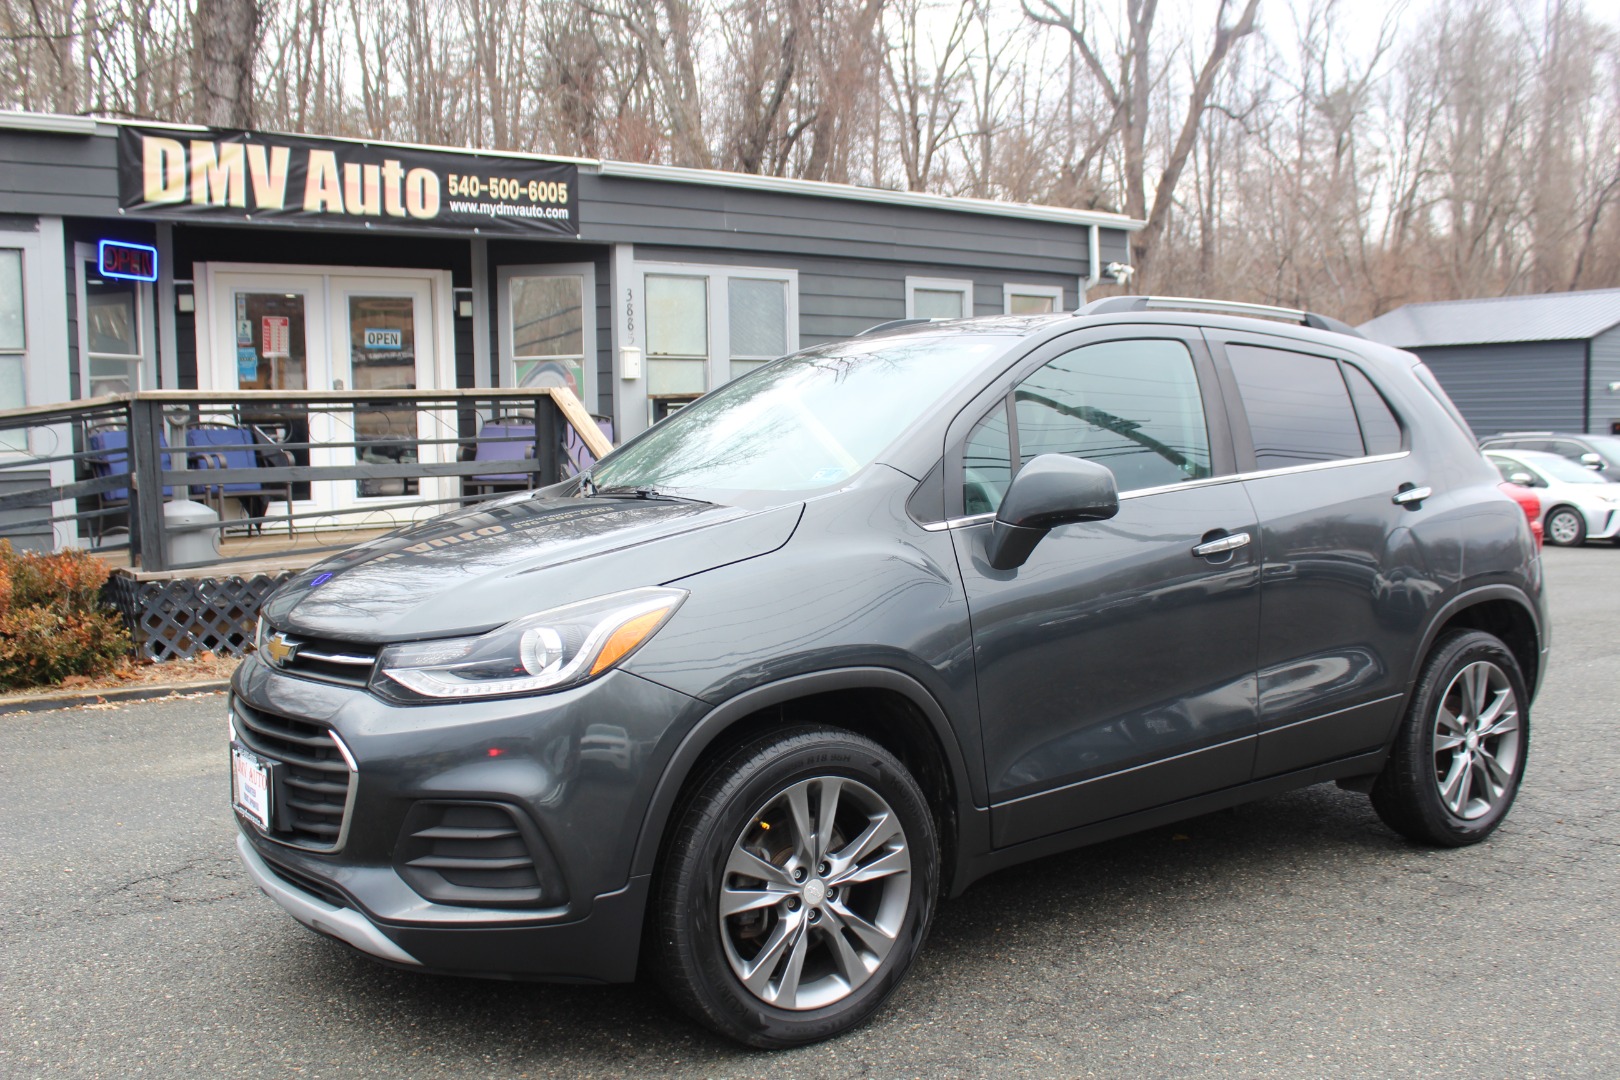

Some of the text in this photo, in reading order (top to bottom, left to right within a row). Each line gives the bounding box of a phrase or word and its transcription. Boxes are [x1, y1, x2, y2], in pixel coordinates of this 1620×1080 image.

[142, 135, 441, 220] DMV Auto
[448, 173, 568, 204] 540-500-6005
[449, 201, 569, 219] www.mydmvauto.com
[368, 332, 398, 345] OPEN
